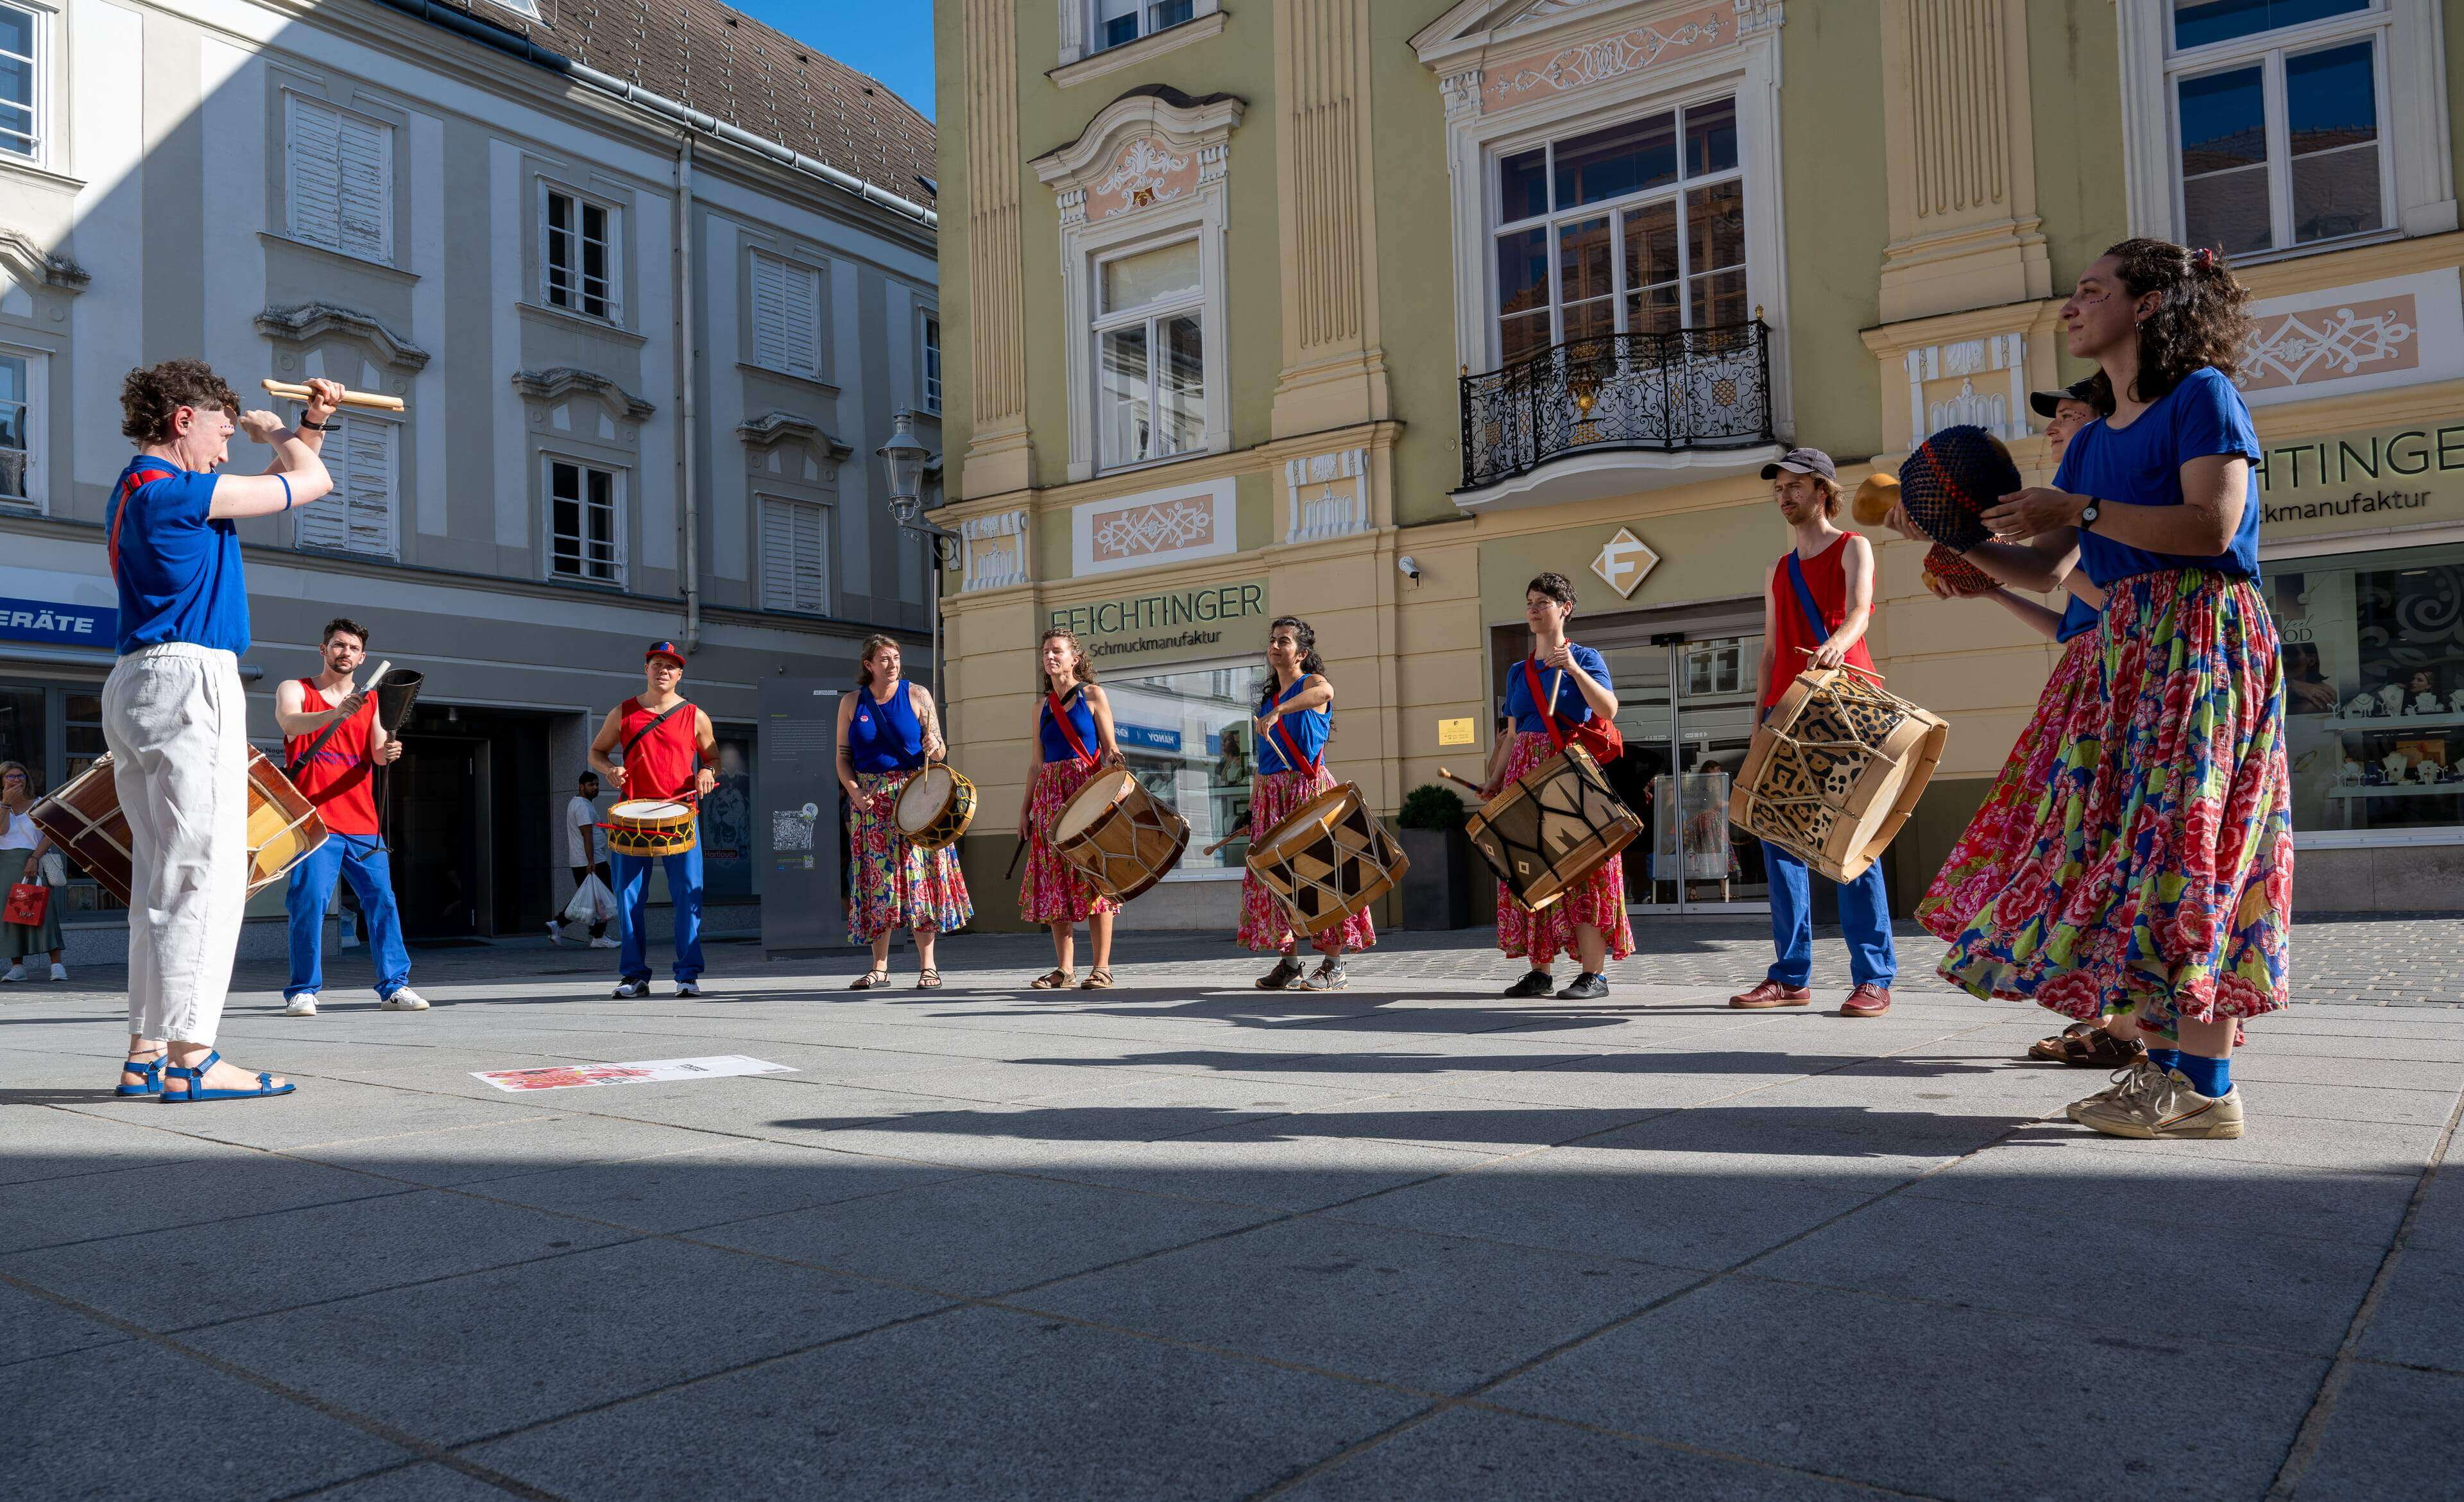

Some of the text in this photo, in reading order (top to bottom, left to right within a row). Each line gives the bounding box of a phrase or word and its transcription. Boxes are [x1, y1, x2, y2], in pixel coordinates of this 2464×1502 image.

[2259, 490, 2431, 524] kmanufaktur
[1051, 585, 1262, 637] FEICHTINGER
[1090, 630, 1222, 657] Schmuckmanufaktur
